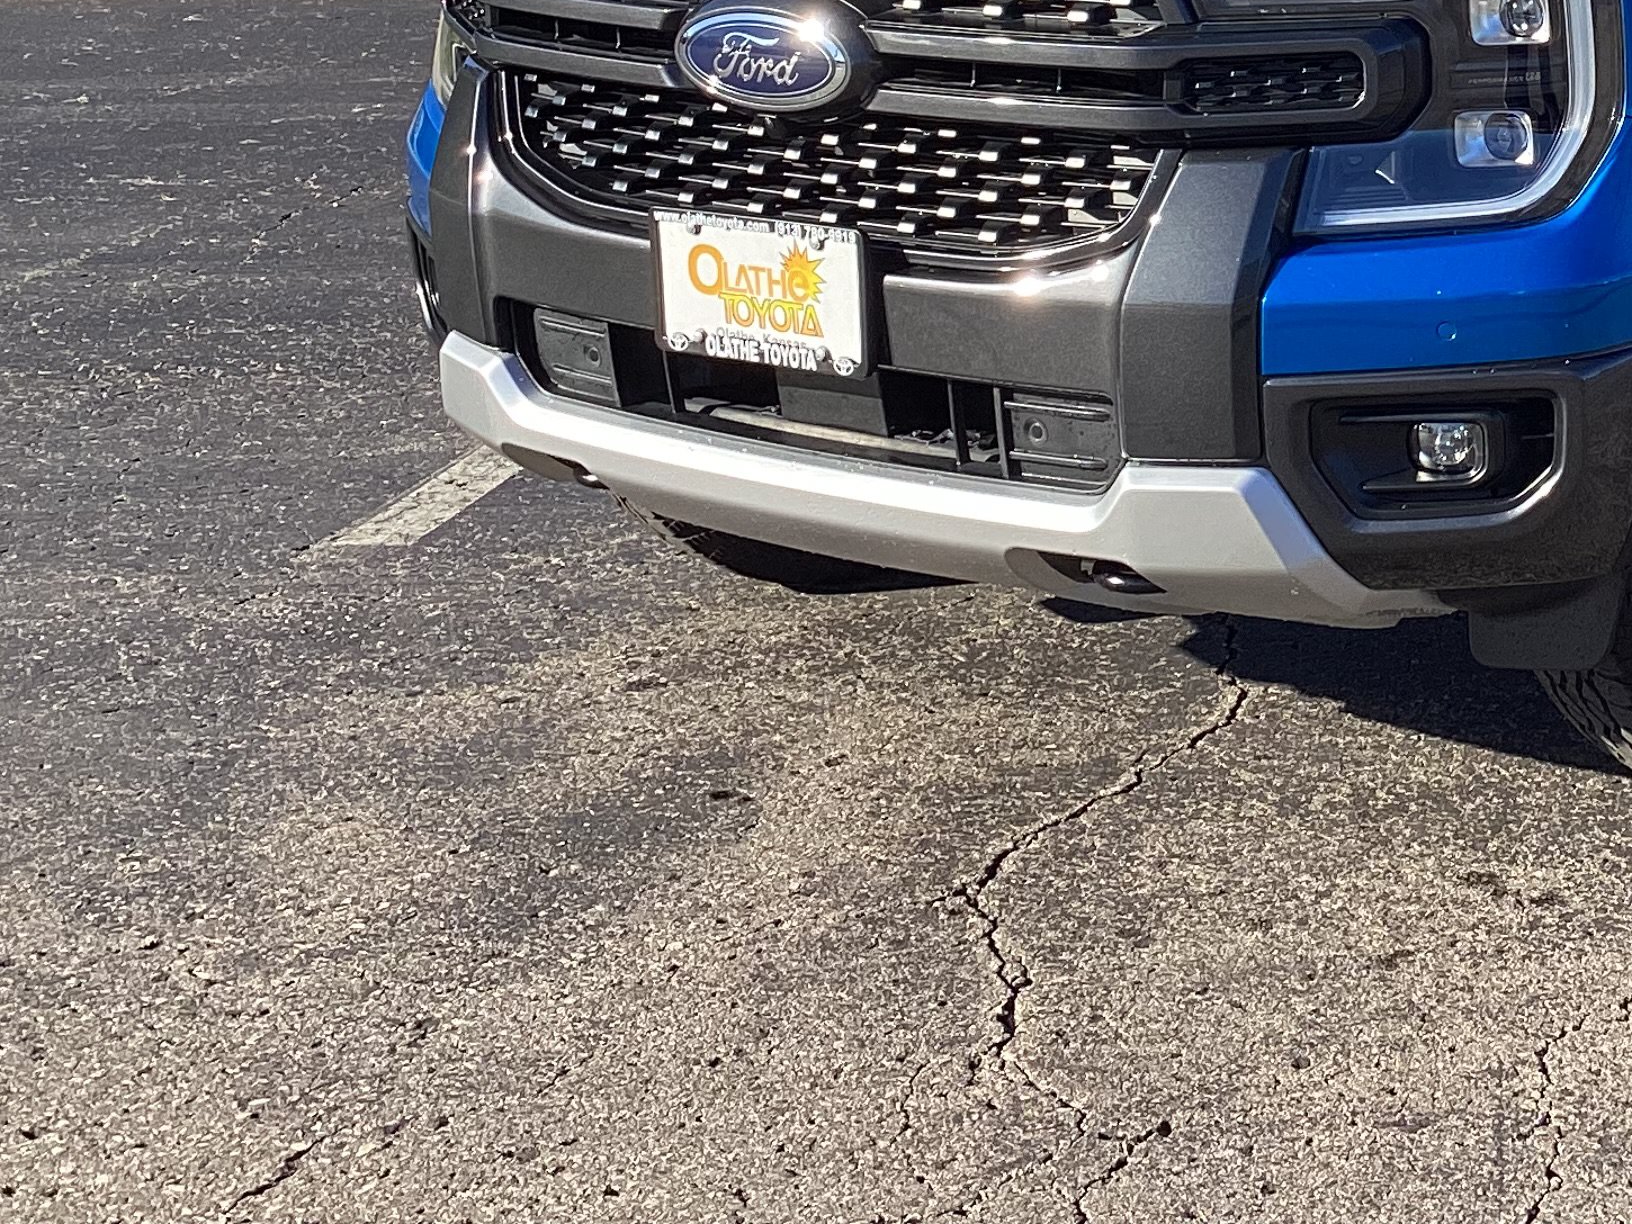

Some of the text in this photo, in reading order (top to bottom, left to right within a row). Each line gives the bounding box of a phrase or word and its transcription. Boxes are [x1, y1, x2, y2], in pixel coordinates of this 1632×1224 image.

[713, 31, 801, 86] Ford
[653, 210, 769, 233] www.olathetoyota.com
[717, 291, 824, 338] TOYOTA
[705, 334, 818, 372] OLATHE TOYOTA
